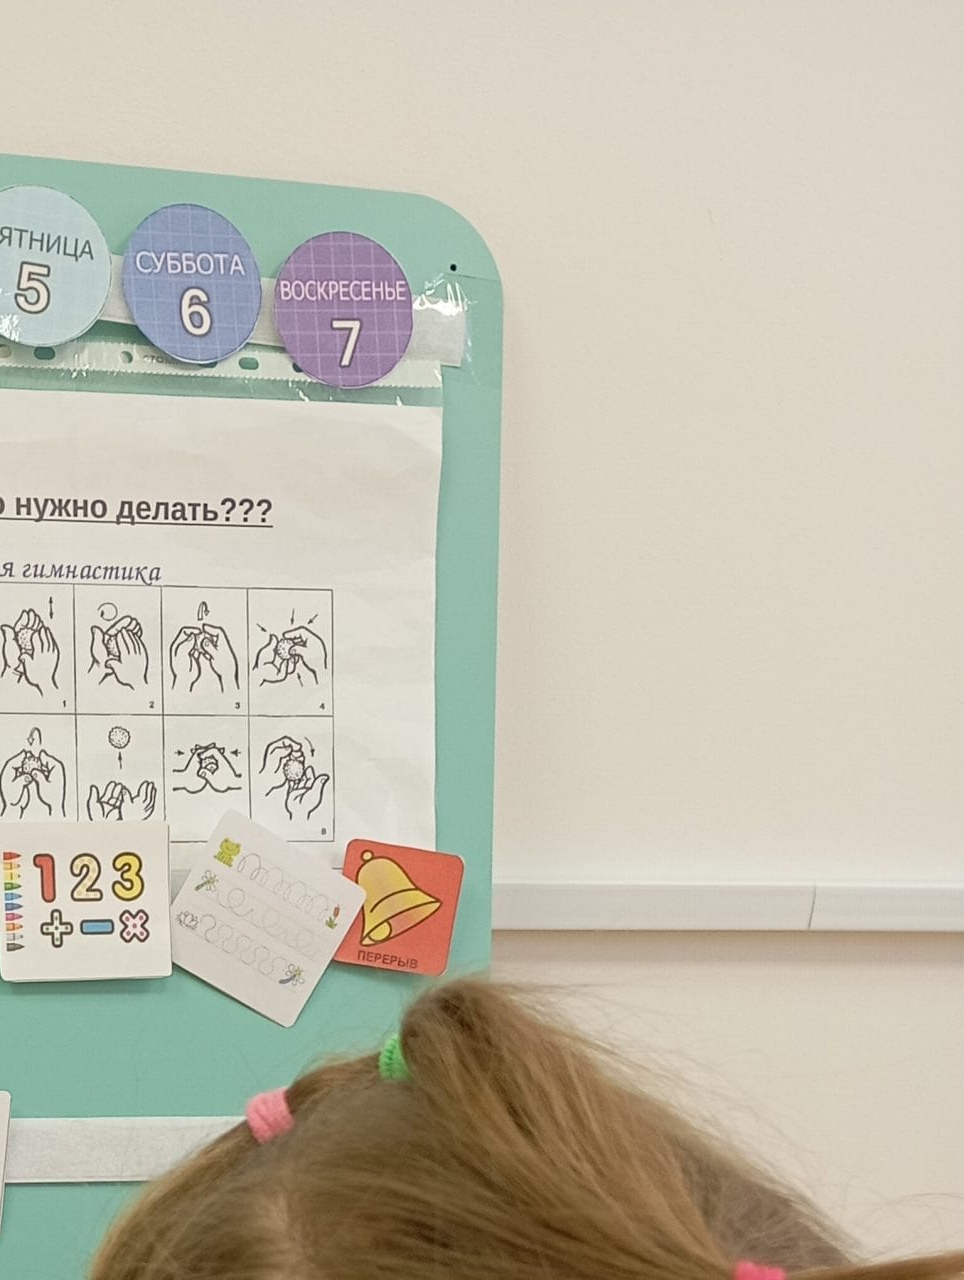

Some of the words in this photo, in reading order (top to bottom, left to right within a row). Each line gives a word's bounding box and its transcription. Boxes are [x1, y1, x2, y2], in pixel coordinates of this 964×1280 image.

[135, 250, 246, 277] СУББОТА
[13, 261, 51, 315] 5
[279, 279, 407, 302] ВОСКРЕСЕНЬЕ
[178, 286, 213, 337] 6
[329, 317, 363, 368] 7
[14, 497, 109, 522] нужно
[115, 498, 274, 527] делать???
[21, 560, 163, 587] гимнастика
[357, 950, 419, 969] ПЕРЕРЫВ
